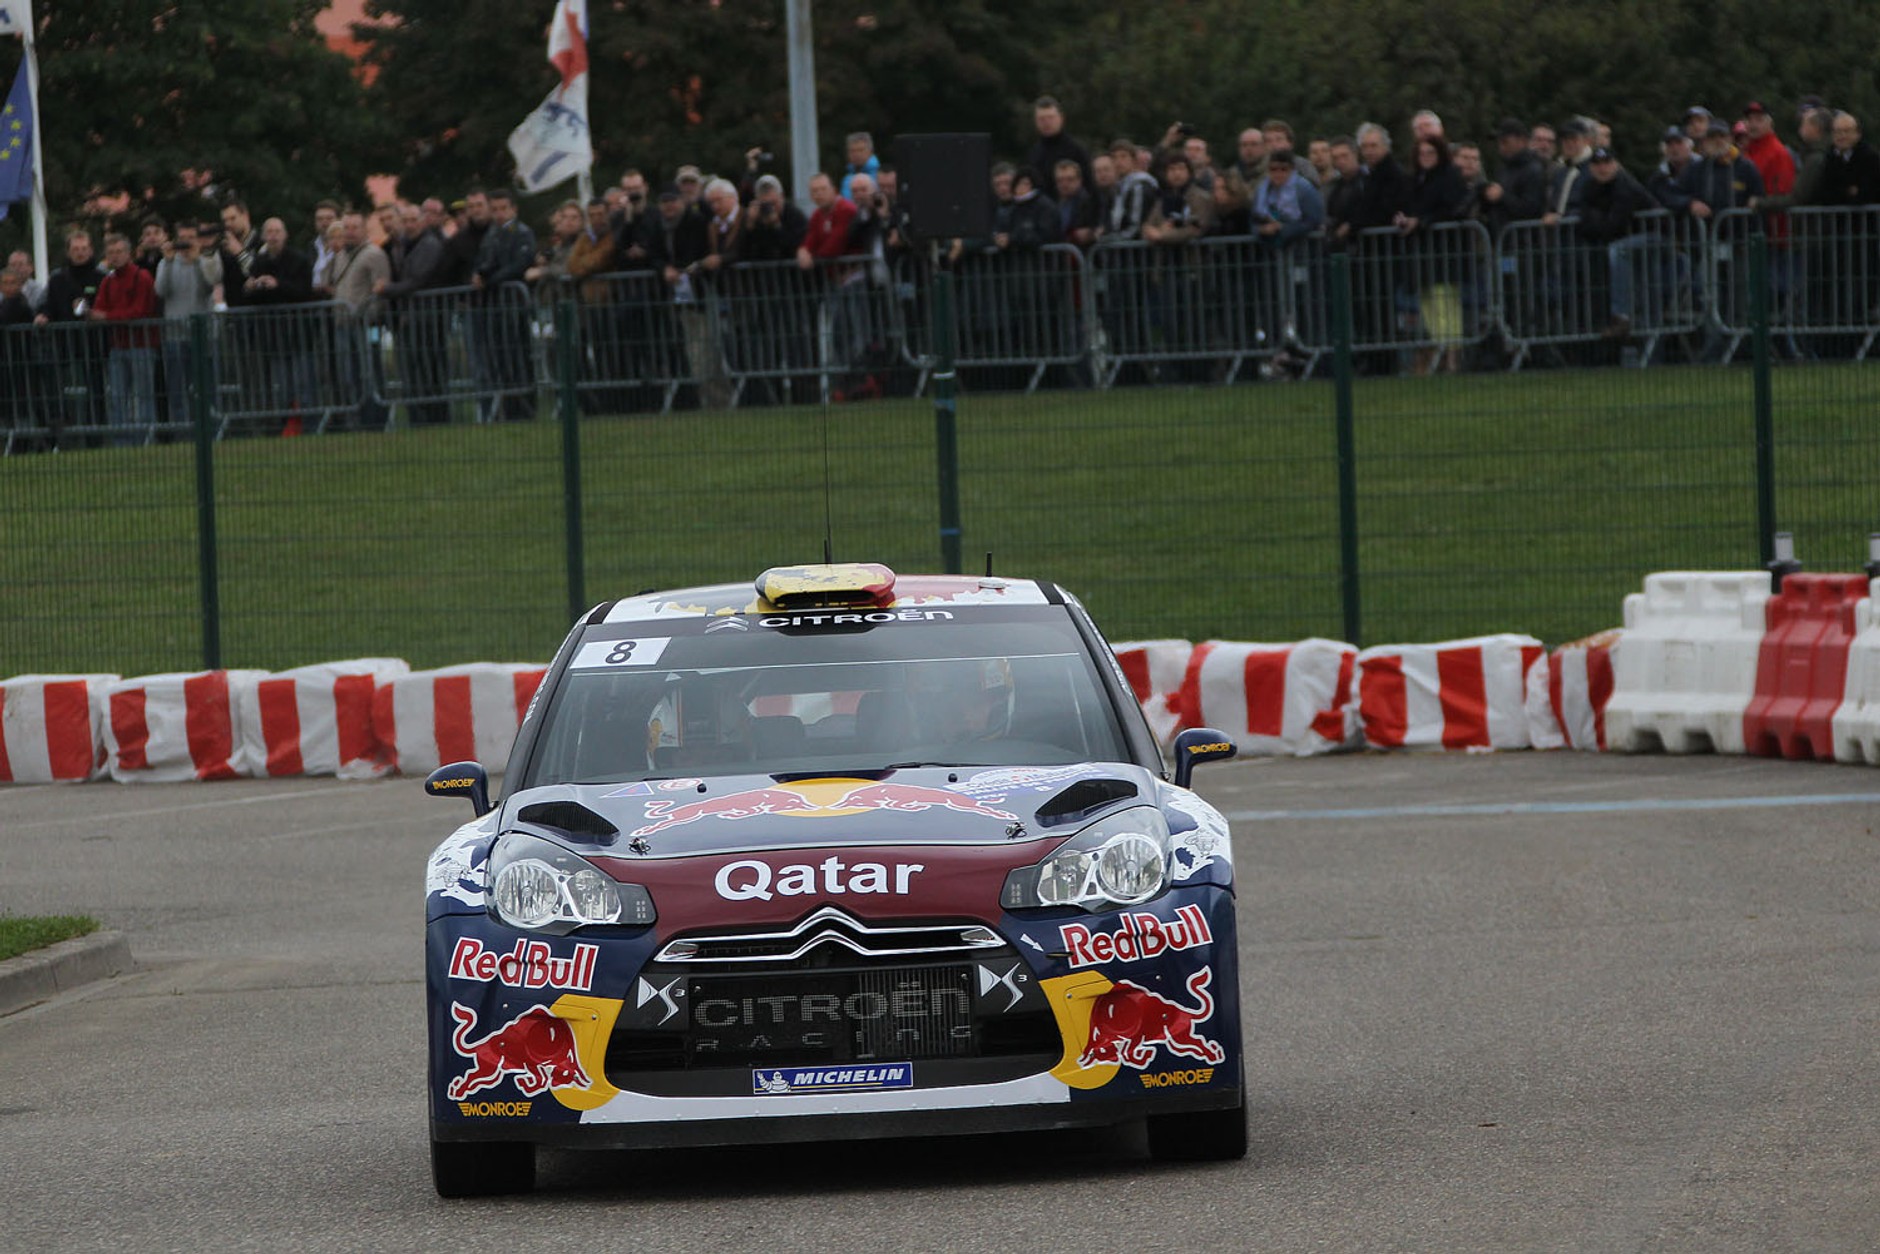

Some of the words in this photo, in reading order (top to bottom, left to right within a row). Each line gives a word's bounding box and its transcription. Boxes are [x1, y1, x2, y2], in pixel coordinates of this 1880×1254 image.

[605, 641, 637, 664] 8
[436, 778, 472, 789] MONROE
[714, 855, 926, 902] Qatar
[793, 1068, 905, 1085] MICHELIN
[1149, 1068, 1207, 1088] MONROE
[466, 1102, 526, 1117] MONROE
